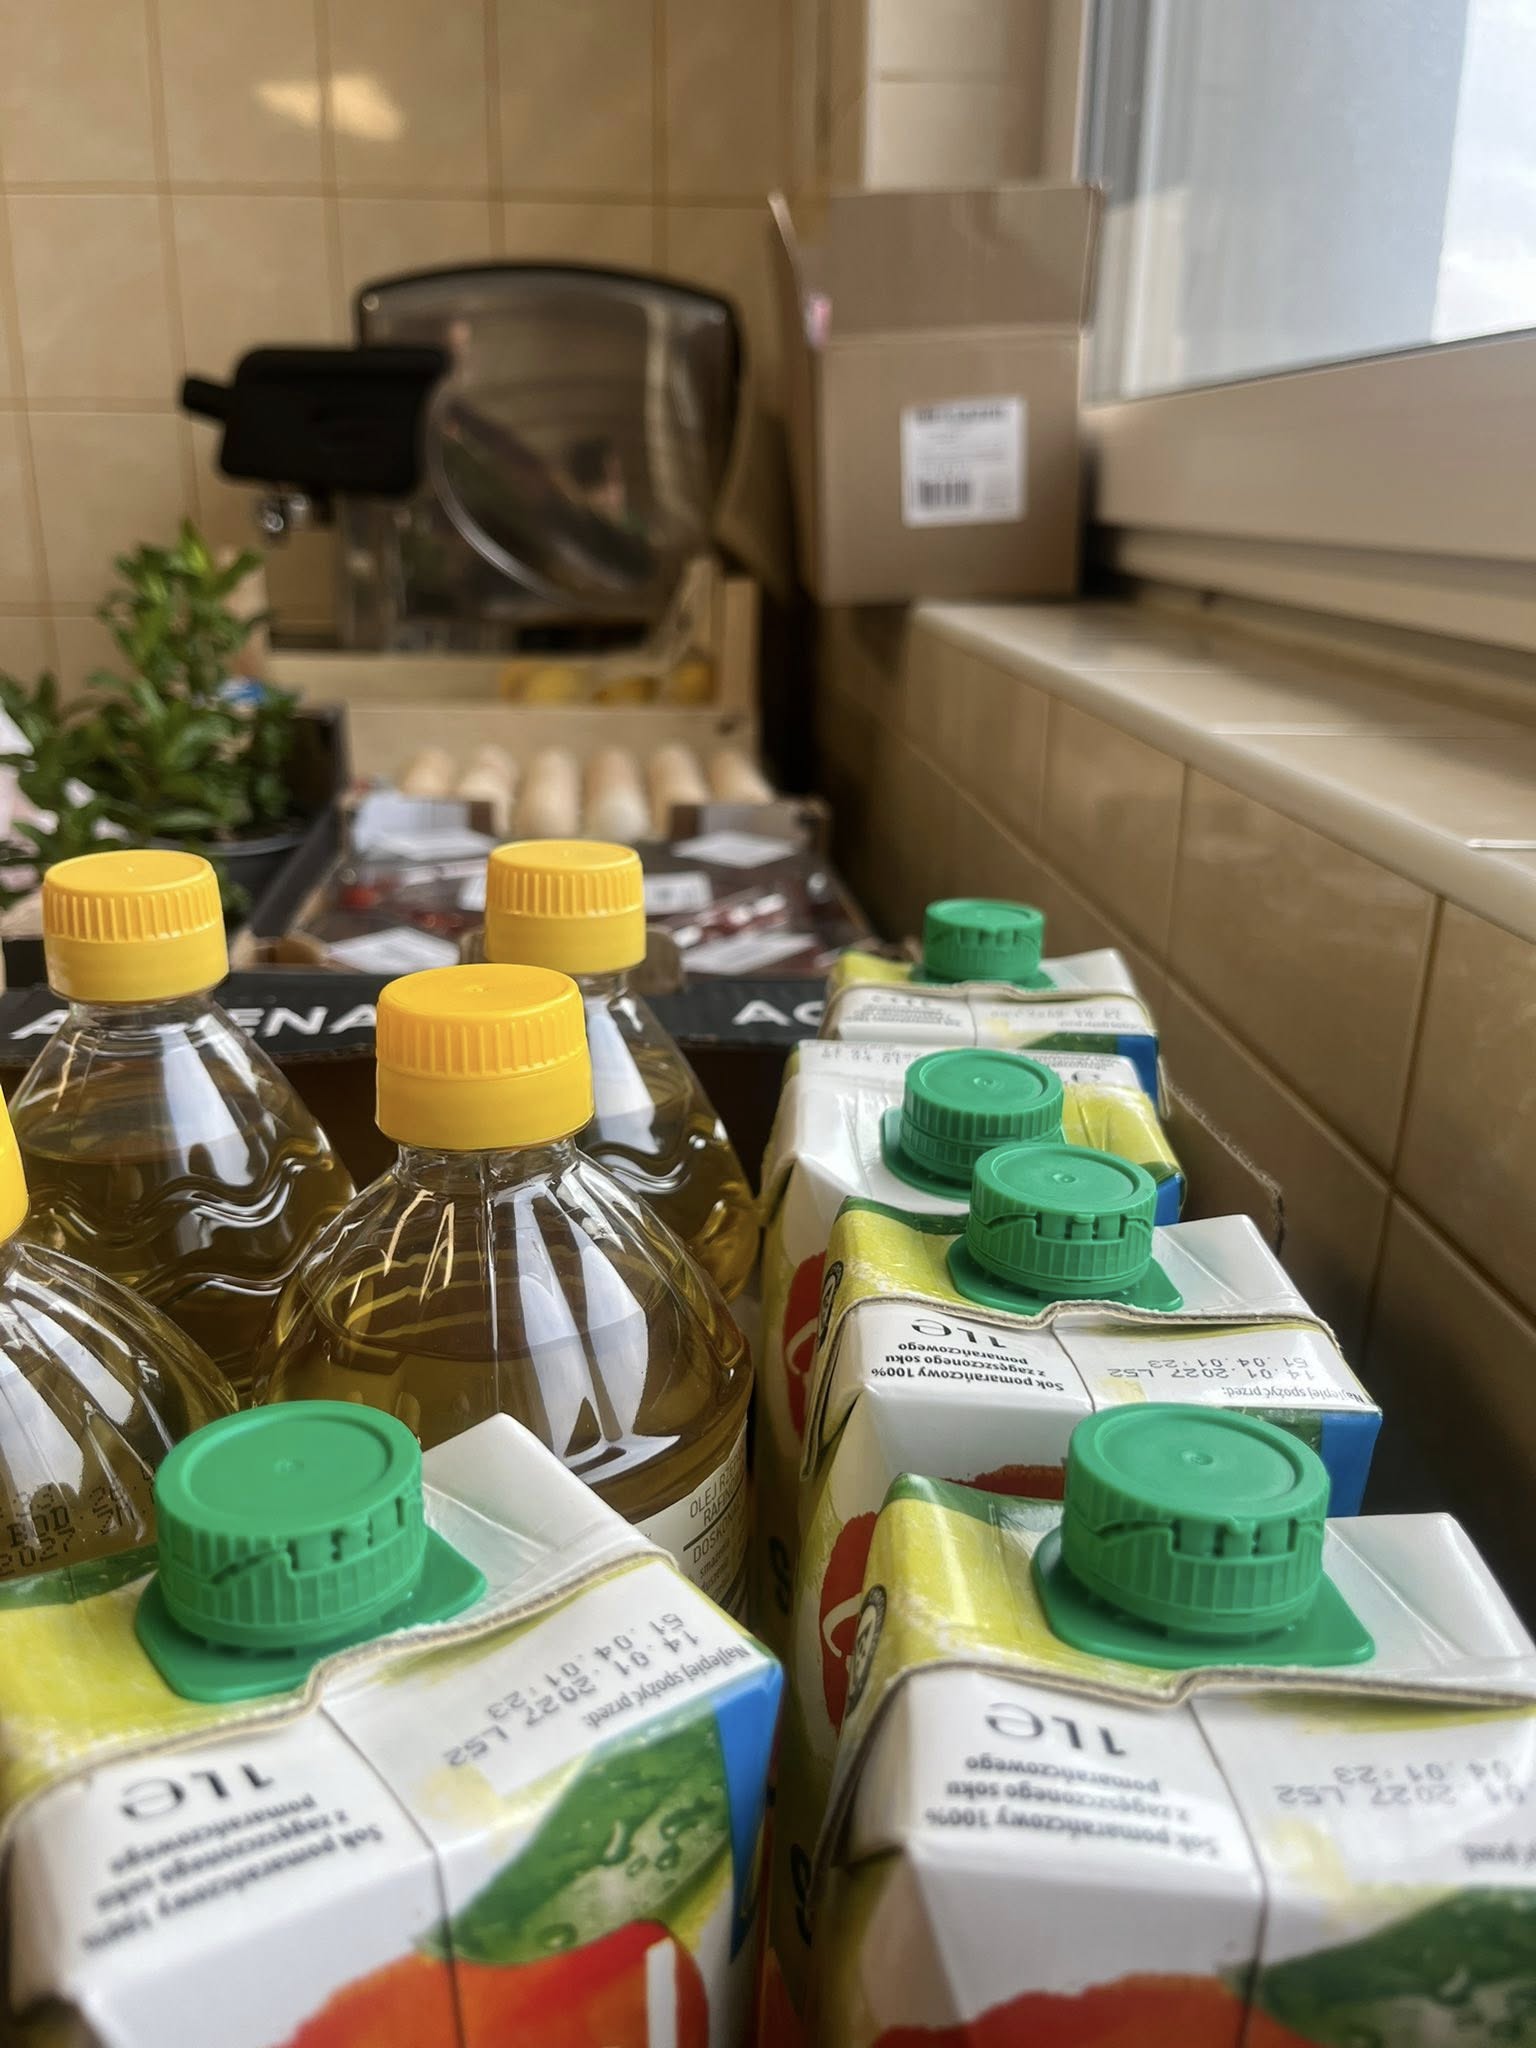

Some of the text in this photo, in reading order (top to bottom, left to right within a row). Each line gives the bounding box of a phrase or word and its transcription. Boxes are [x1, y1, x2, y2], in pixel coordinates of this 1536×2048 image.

[885, 1354, 921, 1364] soku
[898, 1342, 1028, 1365] pomarańczowego
[924, 1356, 1035, 1377] zagęszczonego
[871, 1367, 1065, 1391] Sok pomarańczowy 100%
[1259, 1386, 1307, 1399] spożyć
[689, 1482, 717, 1518] OLEJ
[582, 1644, 751, 1729] Najlepiej spożyć przed:
[947, 1781, 999, 1799] soku
